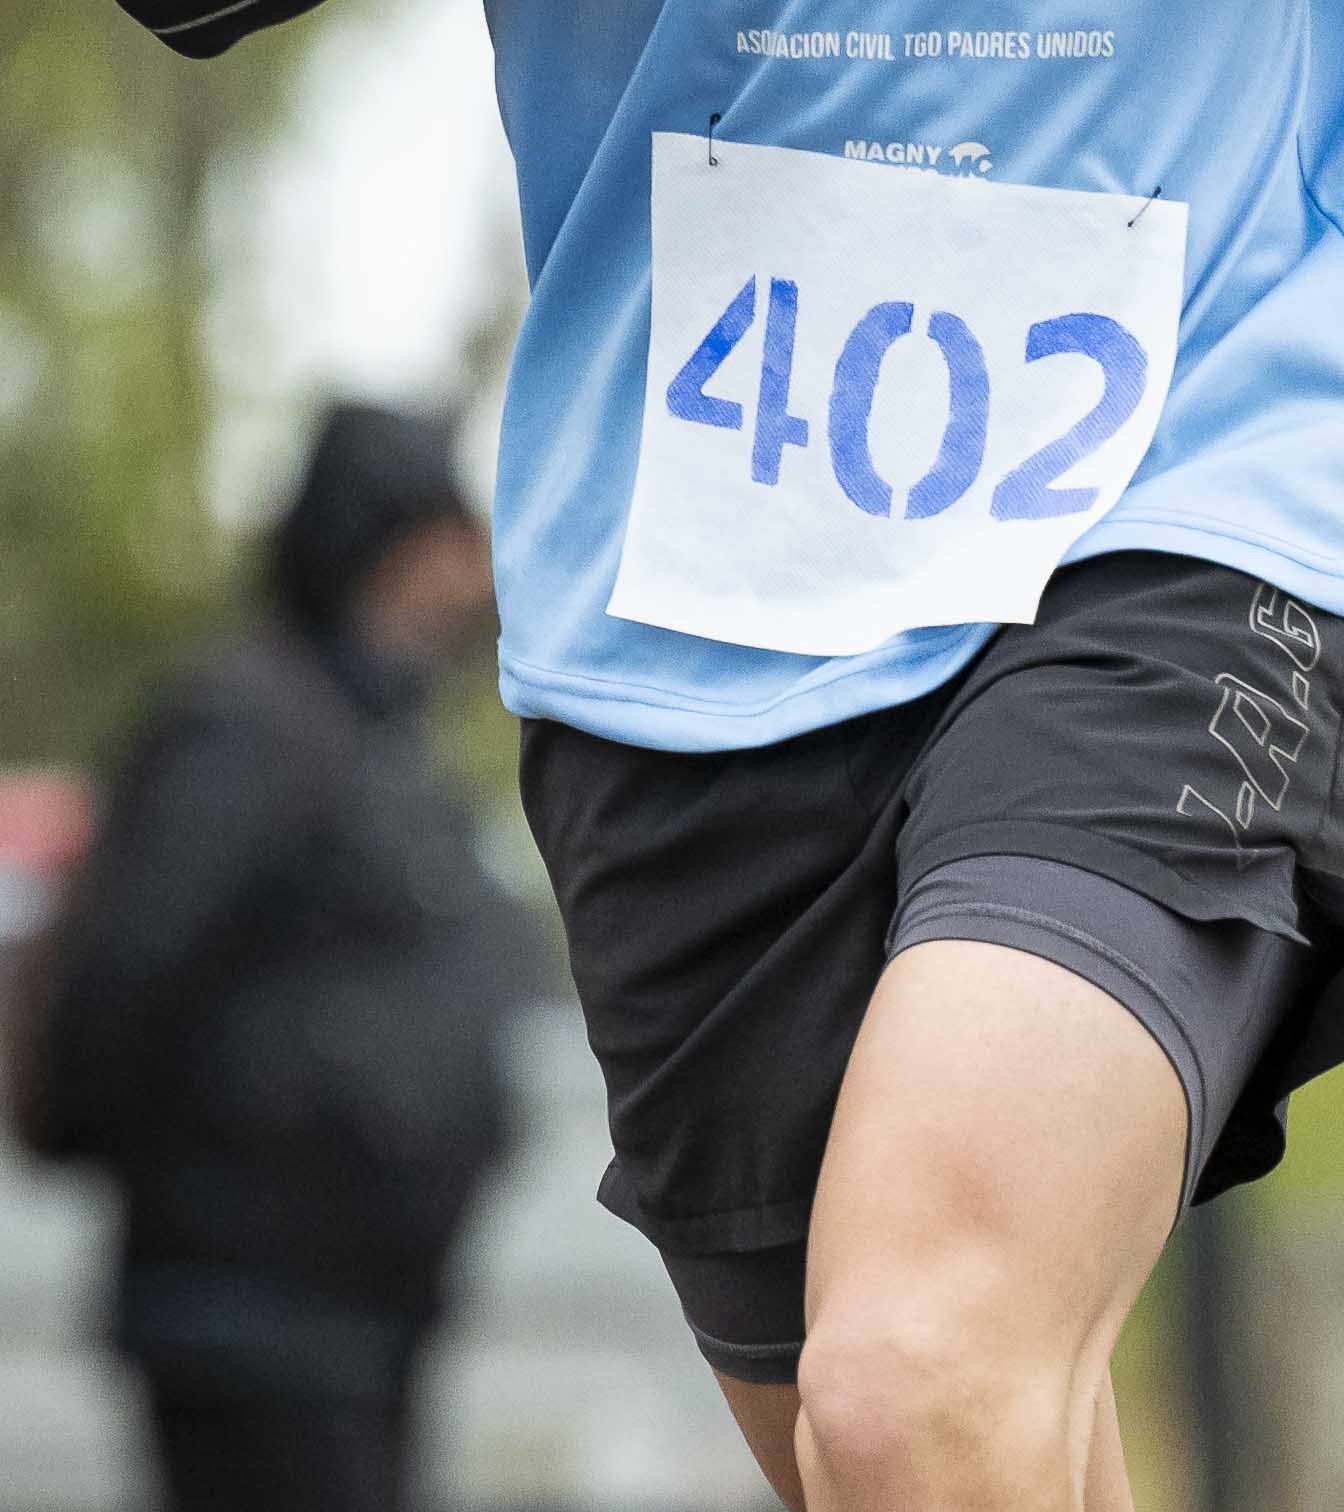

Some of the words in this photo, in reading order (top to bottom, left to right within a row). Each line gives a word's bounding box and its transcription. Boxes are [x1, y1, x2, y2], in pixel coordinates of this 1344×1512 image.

[846, 31, 896, 61] CIVIL
[947, 30, 1030, 60] PADRES
[1036, 30, 1115, 59] UNIDOS
[844, 139, 943, 167] MAGNY
[665, 273, 1149, 522] 402
